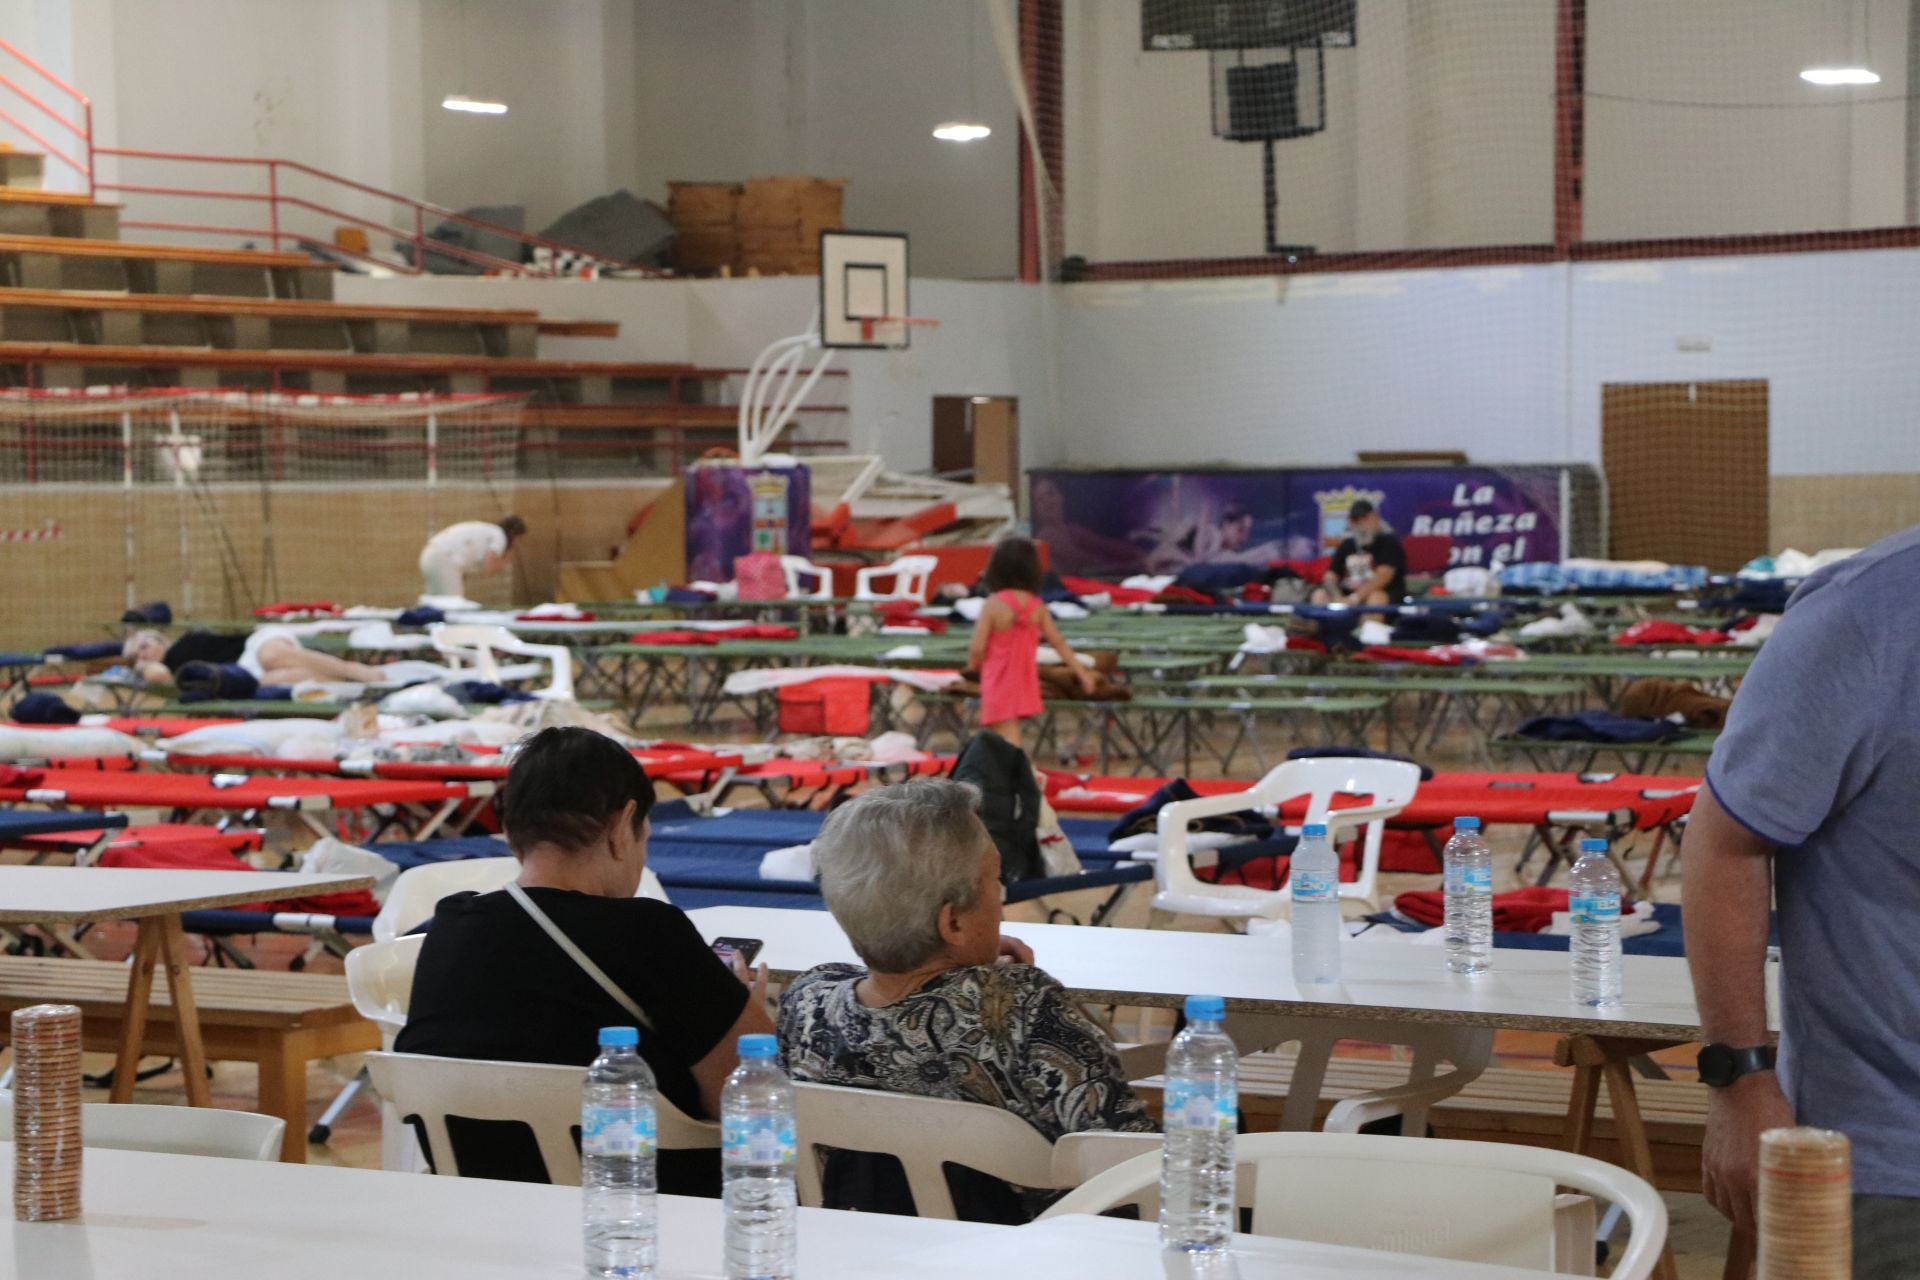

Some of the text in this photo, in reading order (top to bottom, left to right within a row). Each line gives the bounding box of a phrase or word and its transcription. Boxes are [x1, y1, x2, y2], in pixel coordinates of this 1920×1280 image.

[1452, 483, 1495, 507] La
[1411, 511, 1537, 537] Bañeza
[1491, 536, 1526, 563] el
